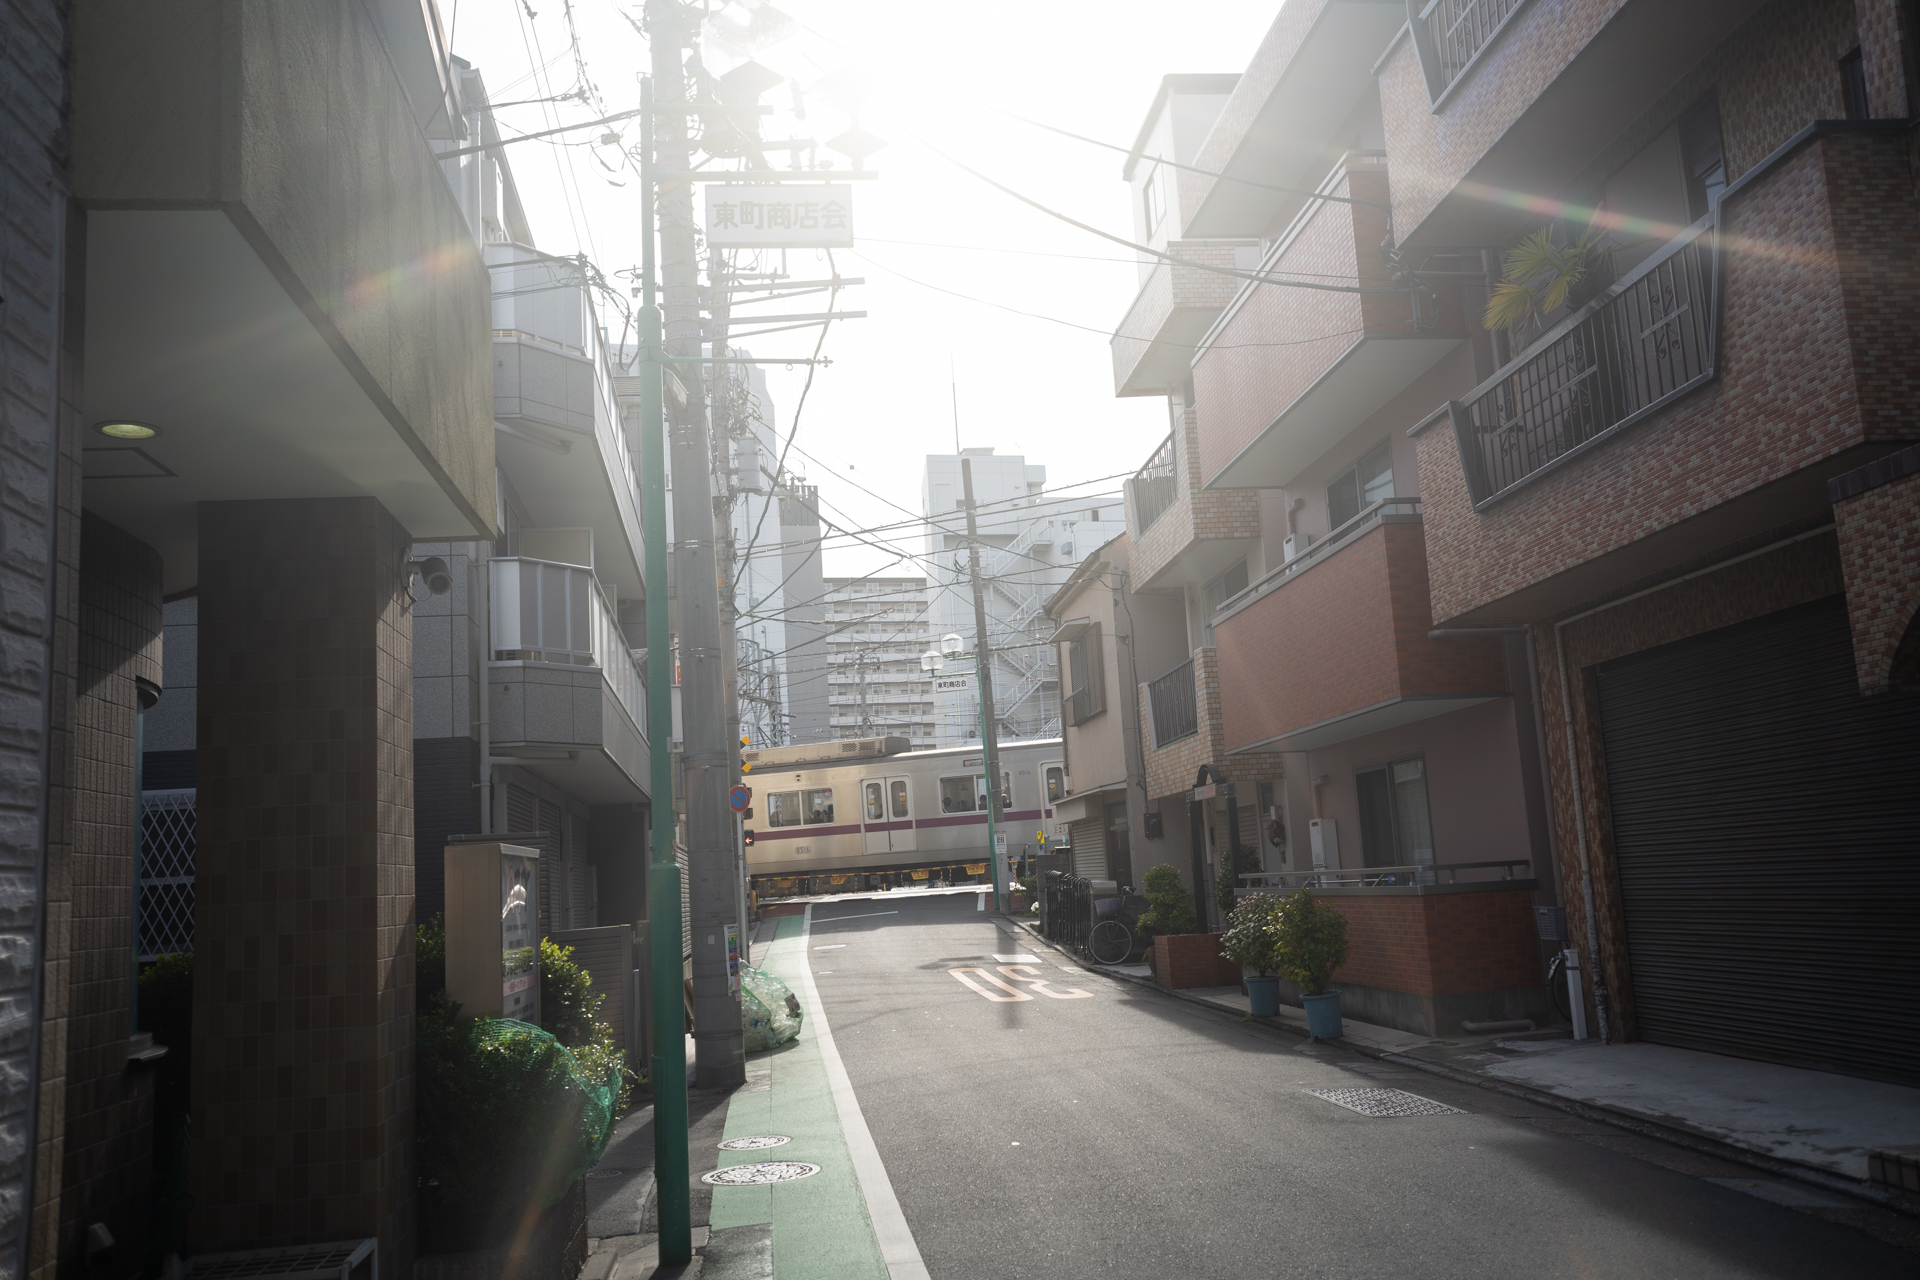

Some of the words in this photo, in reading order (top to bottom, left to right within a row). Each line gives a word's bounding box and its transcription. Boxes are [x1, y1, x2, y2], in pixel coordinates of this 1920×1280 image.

[712, 200, 847, 230] 東町商店会
[937, 680, 967, 689] 東町商店会
[796, 846, 811, 854] 8516
[948, 965, 1094, 1002] 30
